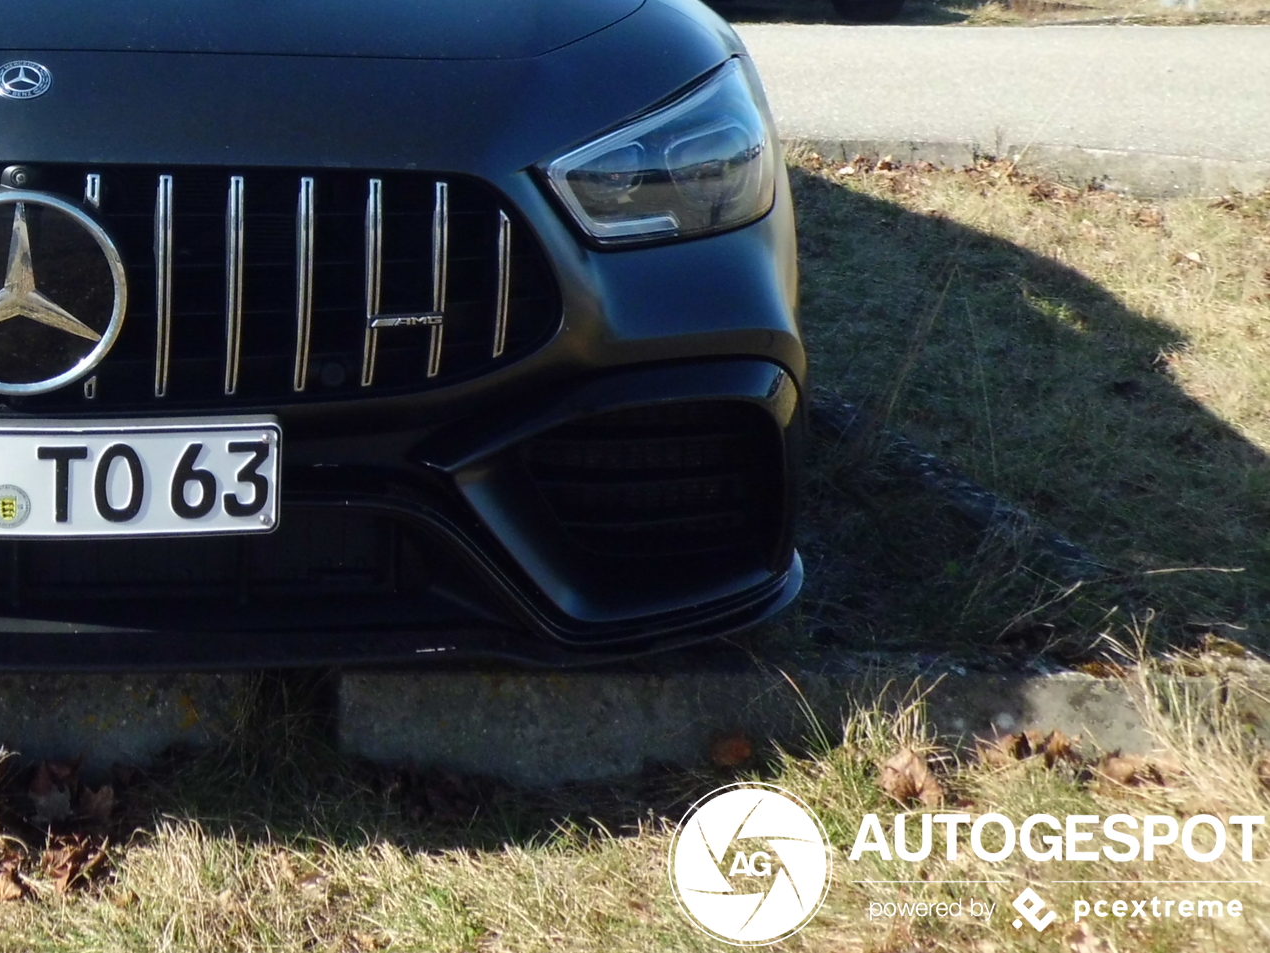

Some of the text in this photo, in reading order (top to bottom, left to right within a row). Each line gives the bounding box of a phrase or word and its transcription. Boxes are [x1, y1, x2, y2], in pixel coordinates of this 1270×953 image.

[394, 315, 443, 326] AMG
[37, 443, 145, 523] TO
[170, 441, 270, 521] 63
